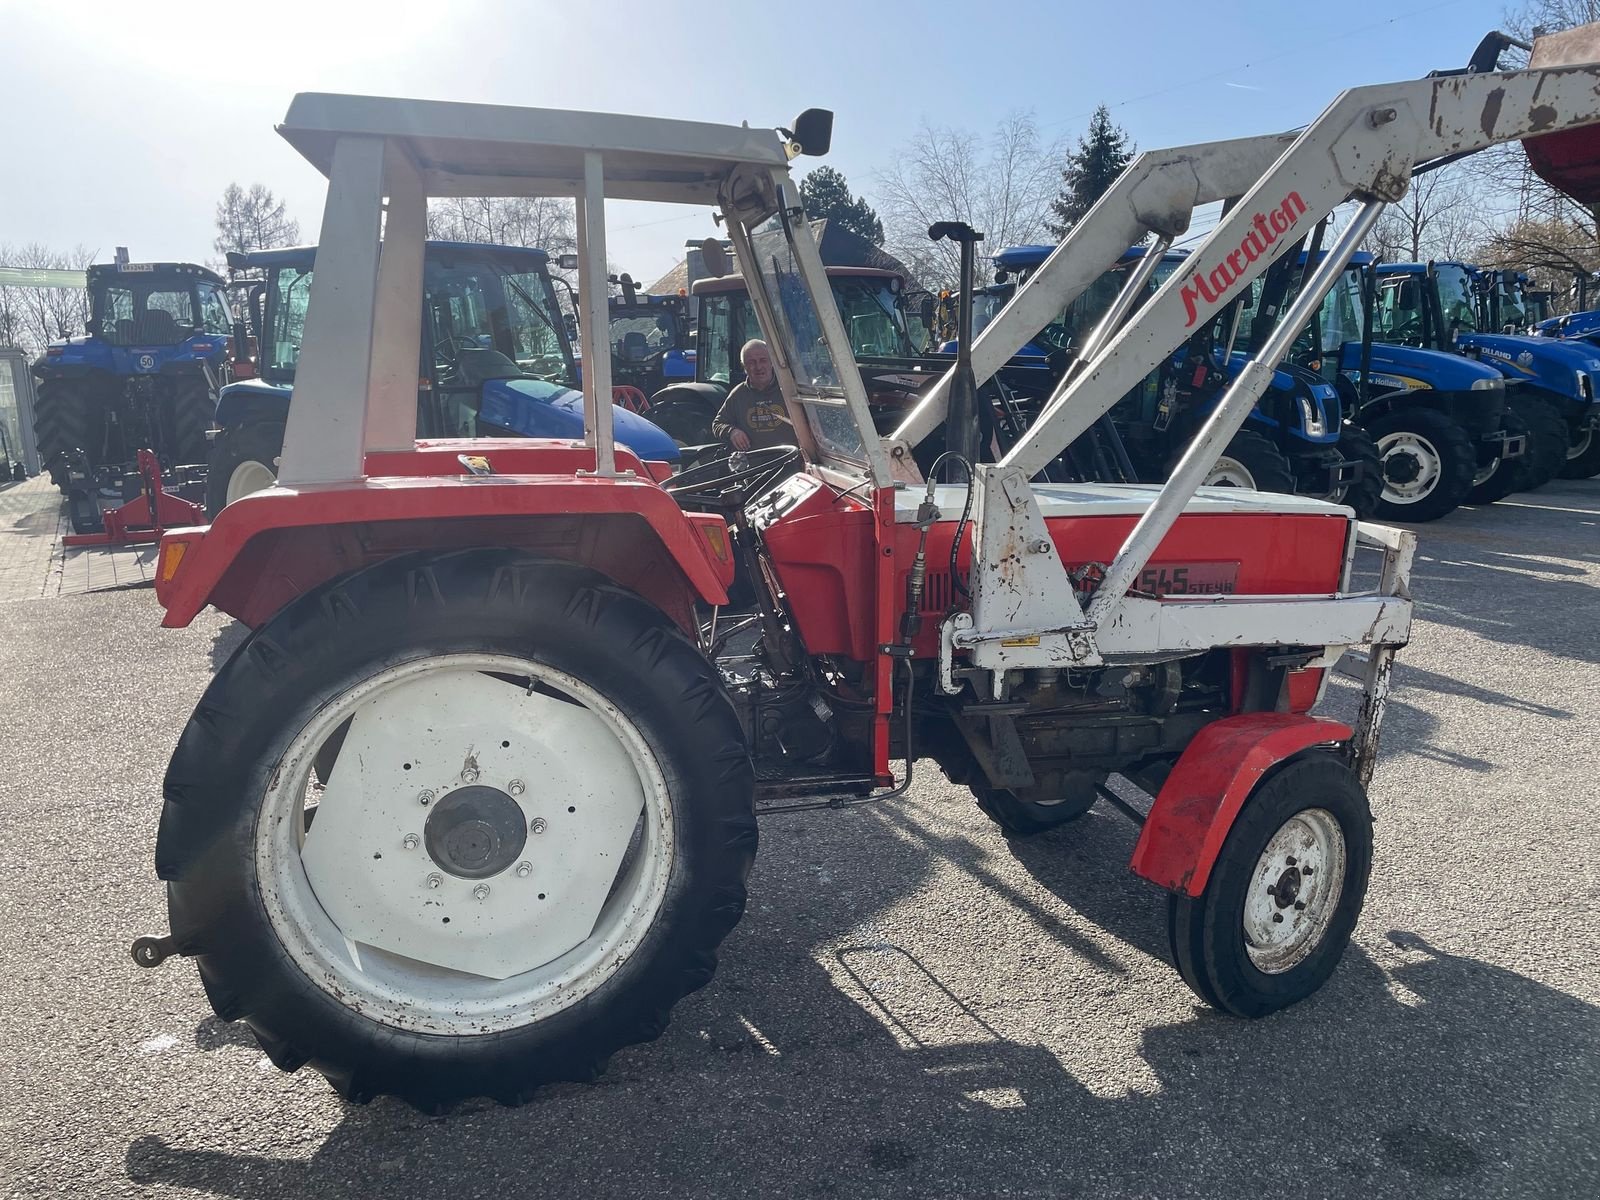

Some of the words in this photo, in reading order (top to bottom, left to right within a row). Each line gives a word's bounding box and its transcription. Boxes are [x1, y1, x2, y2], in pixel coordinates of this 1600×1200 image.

[1180, 191, 1307, 327] Maraton
[1481, 347, 1511, 360] OLLAND
[142, 357, 153, 367] 50
[1375, 378, 1402, 388] Holland
[1142, 568, 1189, 595] 545
[1189, 582, 1233, 595] STEYR
